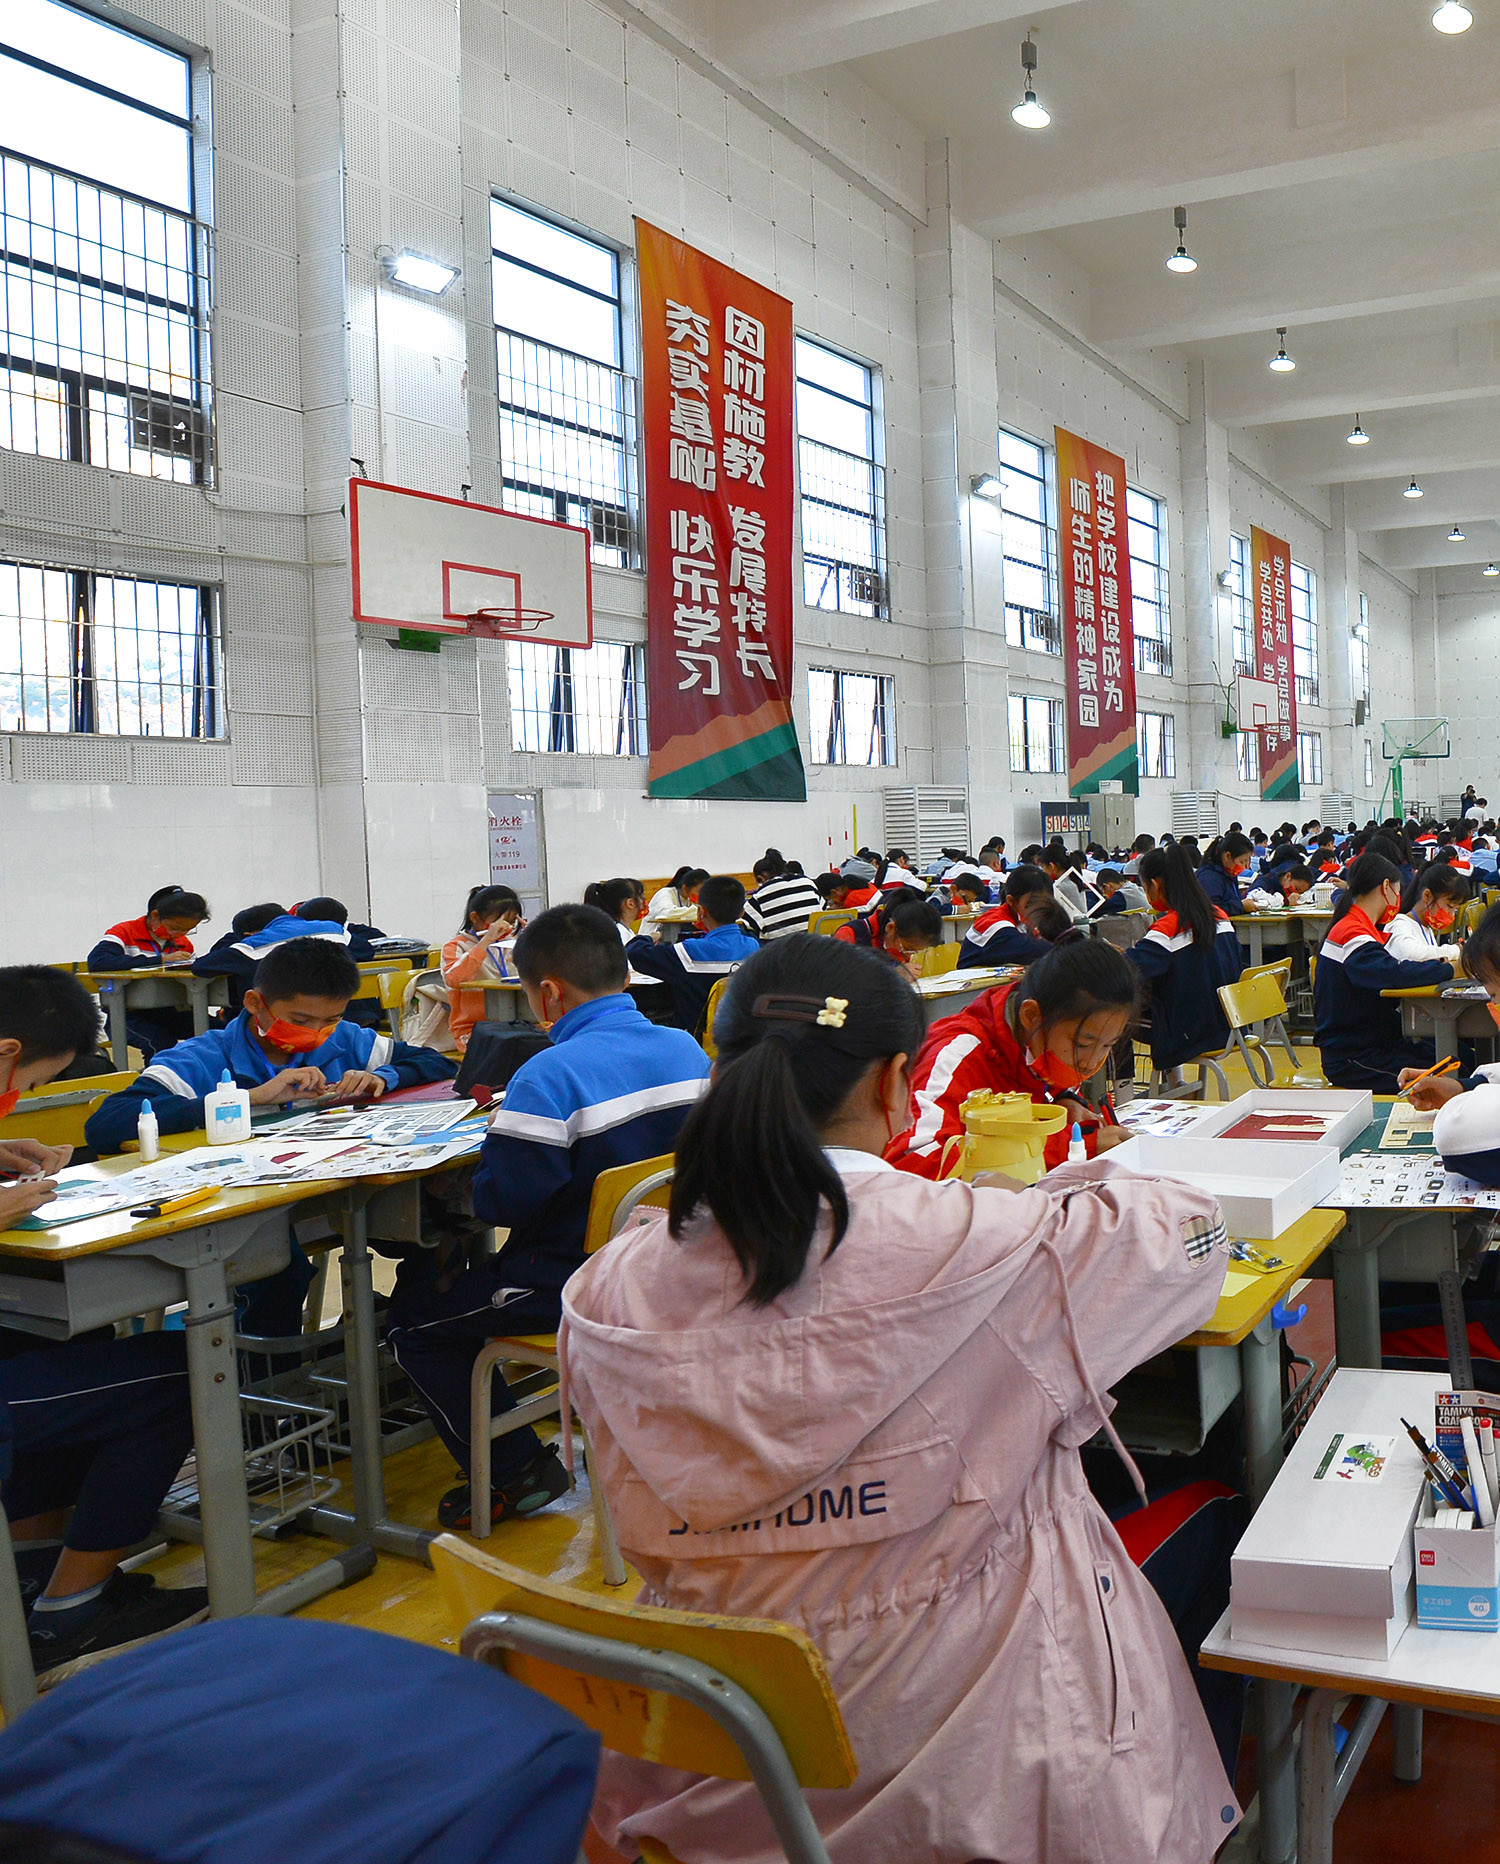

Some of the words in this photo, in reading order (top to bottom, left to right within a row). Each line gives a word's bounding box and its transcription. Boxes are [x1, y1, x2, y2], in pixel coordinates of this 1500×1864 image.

[665, 297, 717, 492] 夯实基础
[722, 305, 766, 490] 因材施教
[669, 509, 722, 697] 快乐学习
[727, 503, 777, 681] 发展特长
[1069, 477, 1100, 728] 师生的精神家园
[1094, 470, 1124, 713] 把学校建设成为
[1438, 1406, 1474, 1416] TAMIYA
